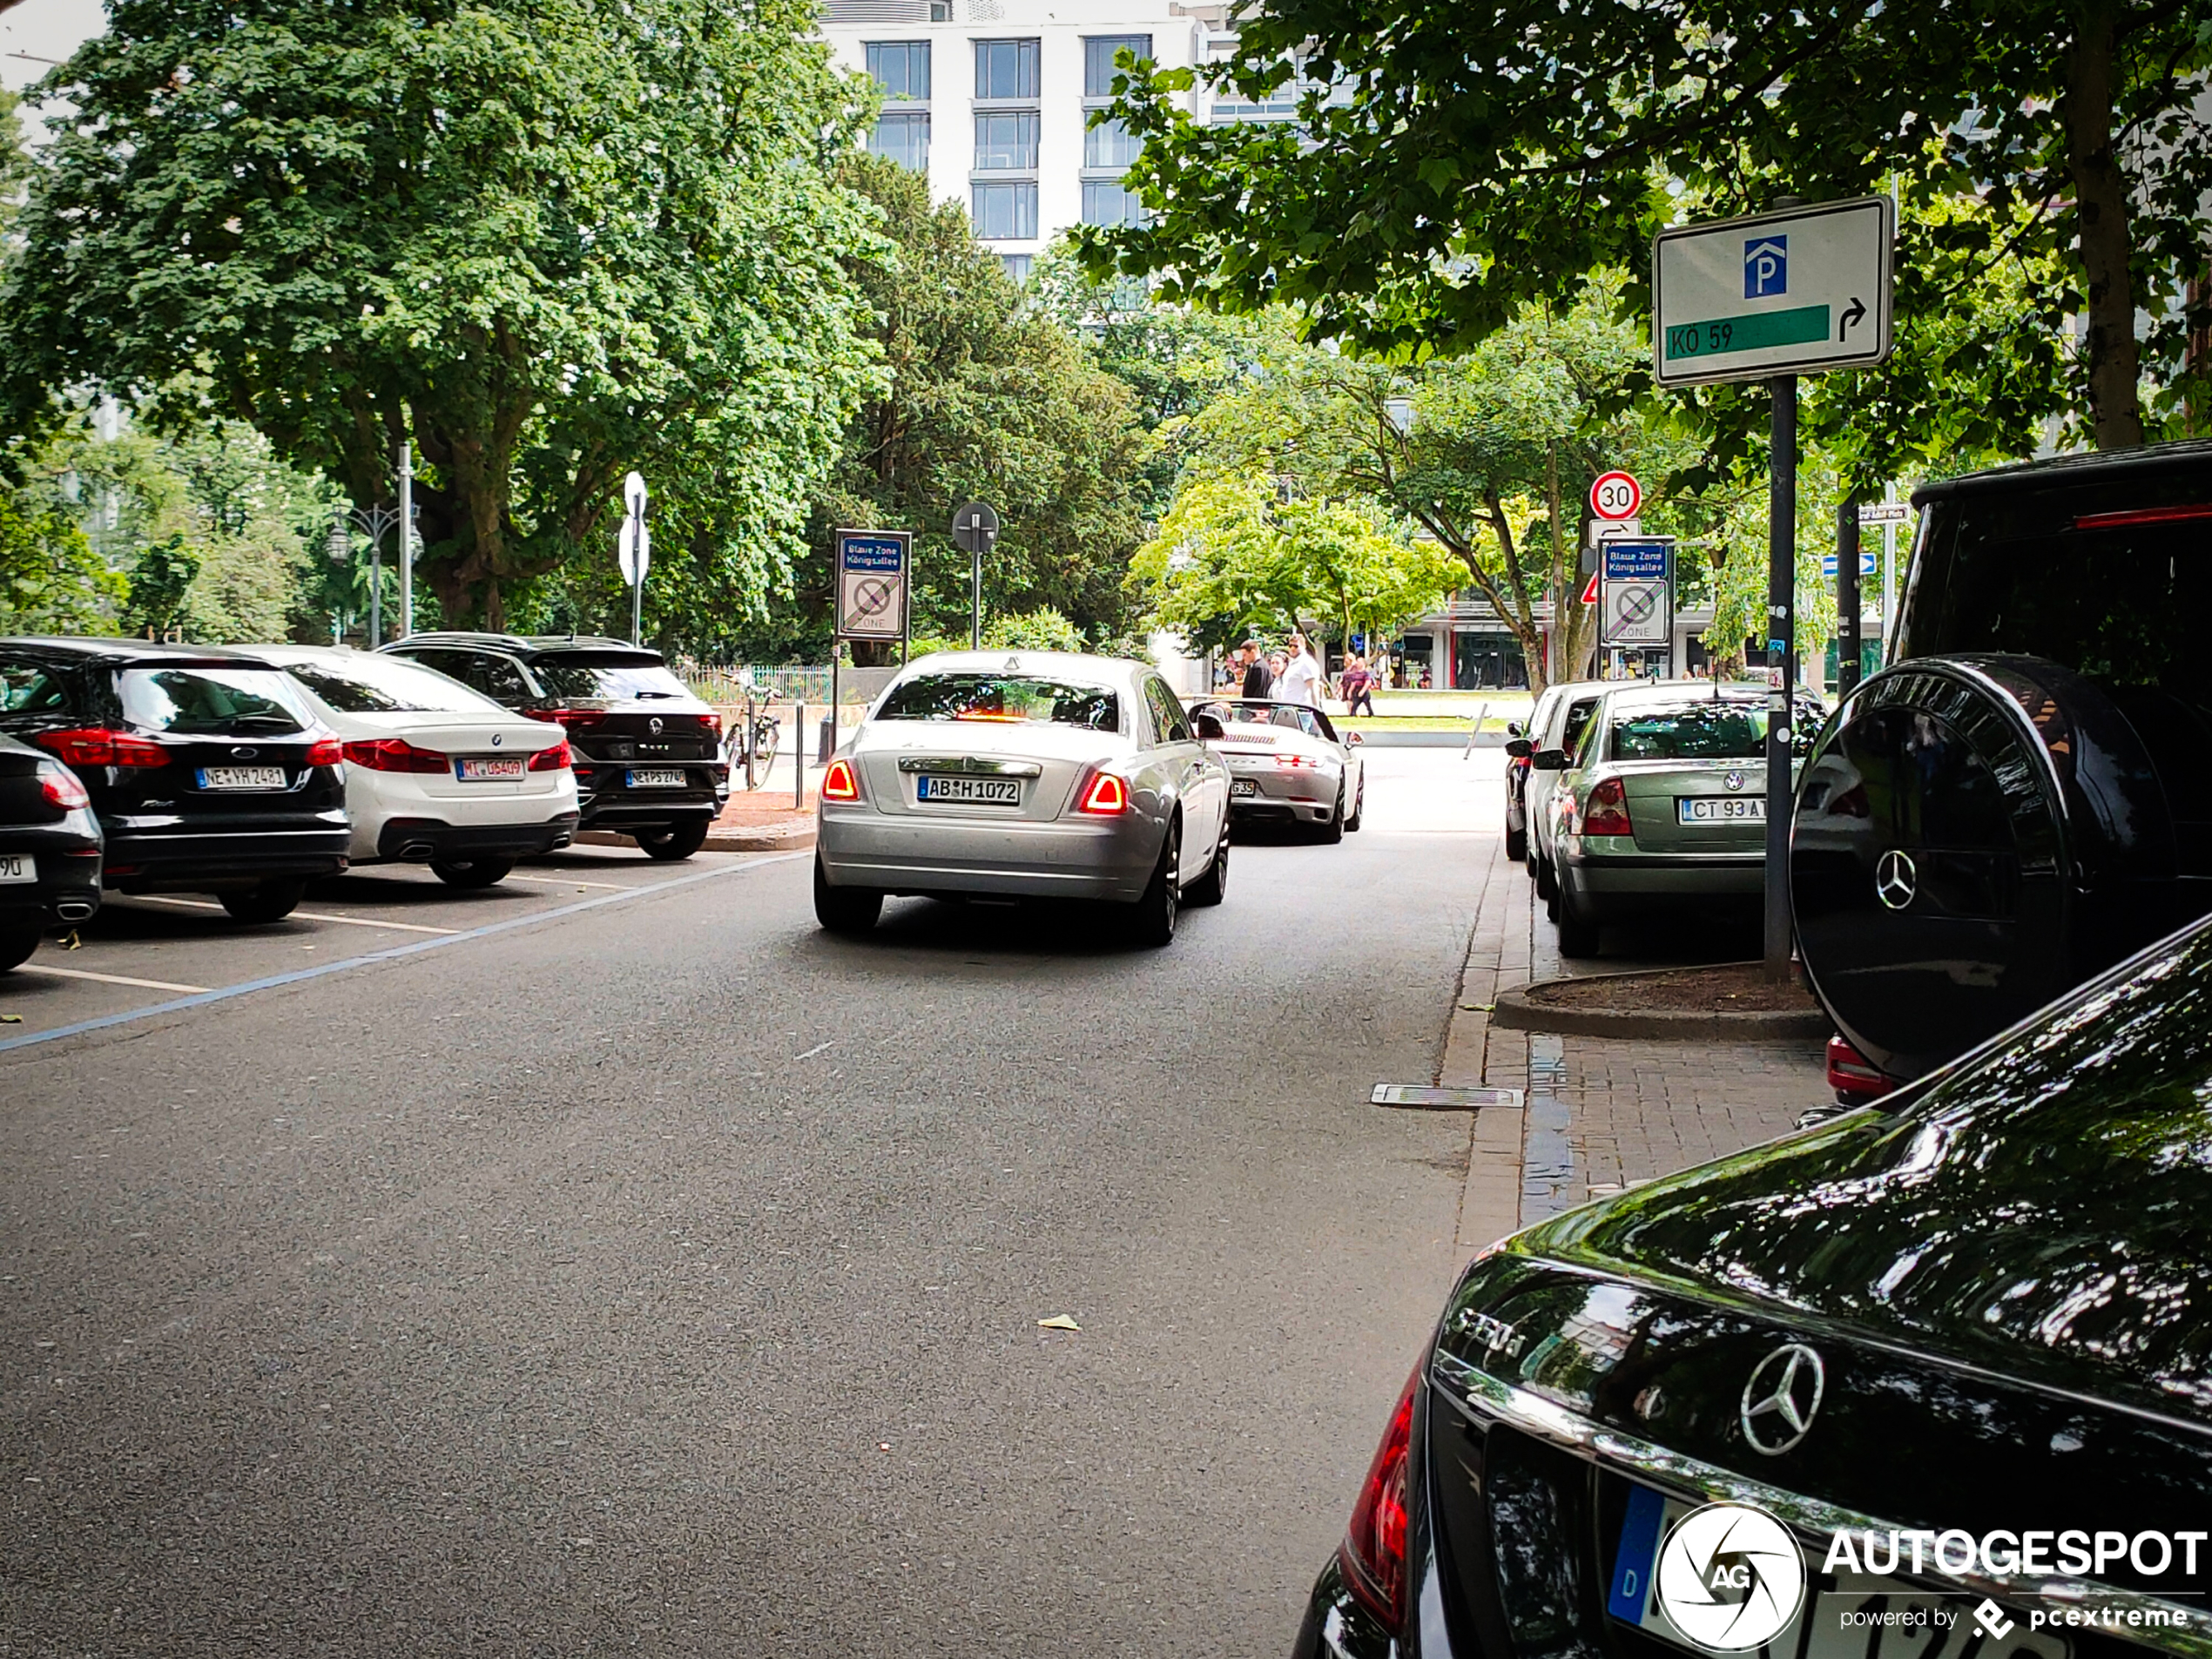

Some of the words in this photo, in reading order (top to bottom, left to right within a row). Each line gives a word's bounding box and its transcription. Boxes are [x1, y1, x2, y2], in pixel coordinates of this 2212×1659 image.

[1757, 256, 1777, 294] P
[1671, 324, 1699, 355] KÖ
[1709, 323, 1733, 349] 59
[1602, 485, 1629, 508] 30
[848, 544, 873, 554] Blaue
[875, 546, 897, 555] Zone
[1609, 551, 1636, 561] Blaue
[1639, 551, 1662, 561] Zone
[846, 555, 898, 566] Königsallee
[1608, 561, 1663, 573] Königsallee
[1694, 801, 1717, 818] CT
[1723, 800, 1745, 817] 93
[1622, 1569, 1637, 1598] D
